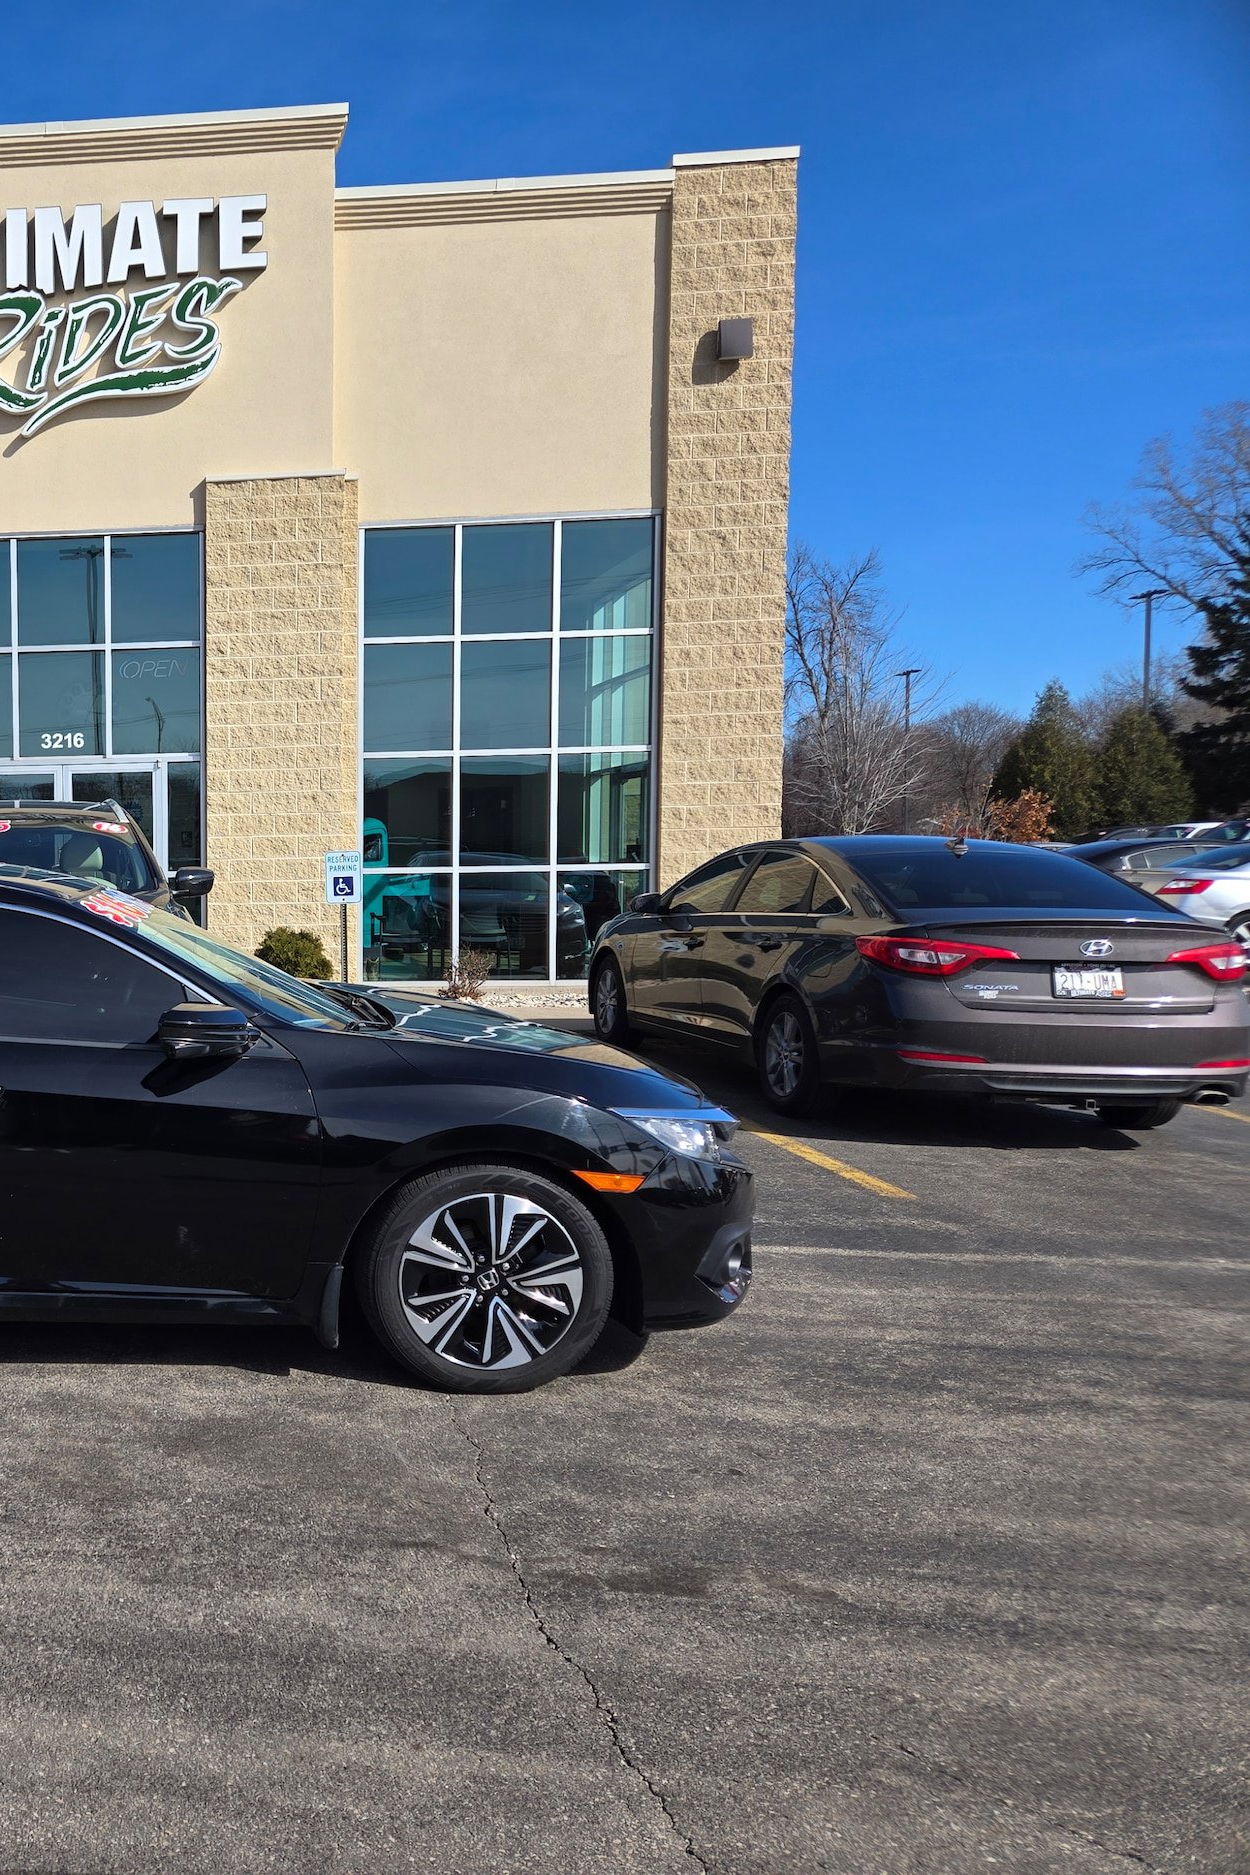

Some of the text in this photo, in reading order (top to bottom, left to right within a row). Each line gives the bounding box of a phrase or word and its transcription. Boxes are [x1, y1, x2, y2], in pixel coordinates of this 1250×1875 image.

[120, 658, 188, 679] OPEN
[41, 732, 85, 749] 3216
[327, 855, 358, 863] RESERVED
